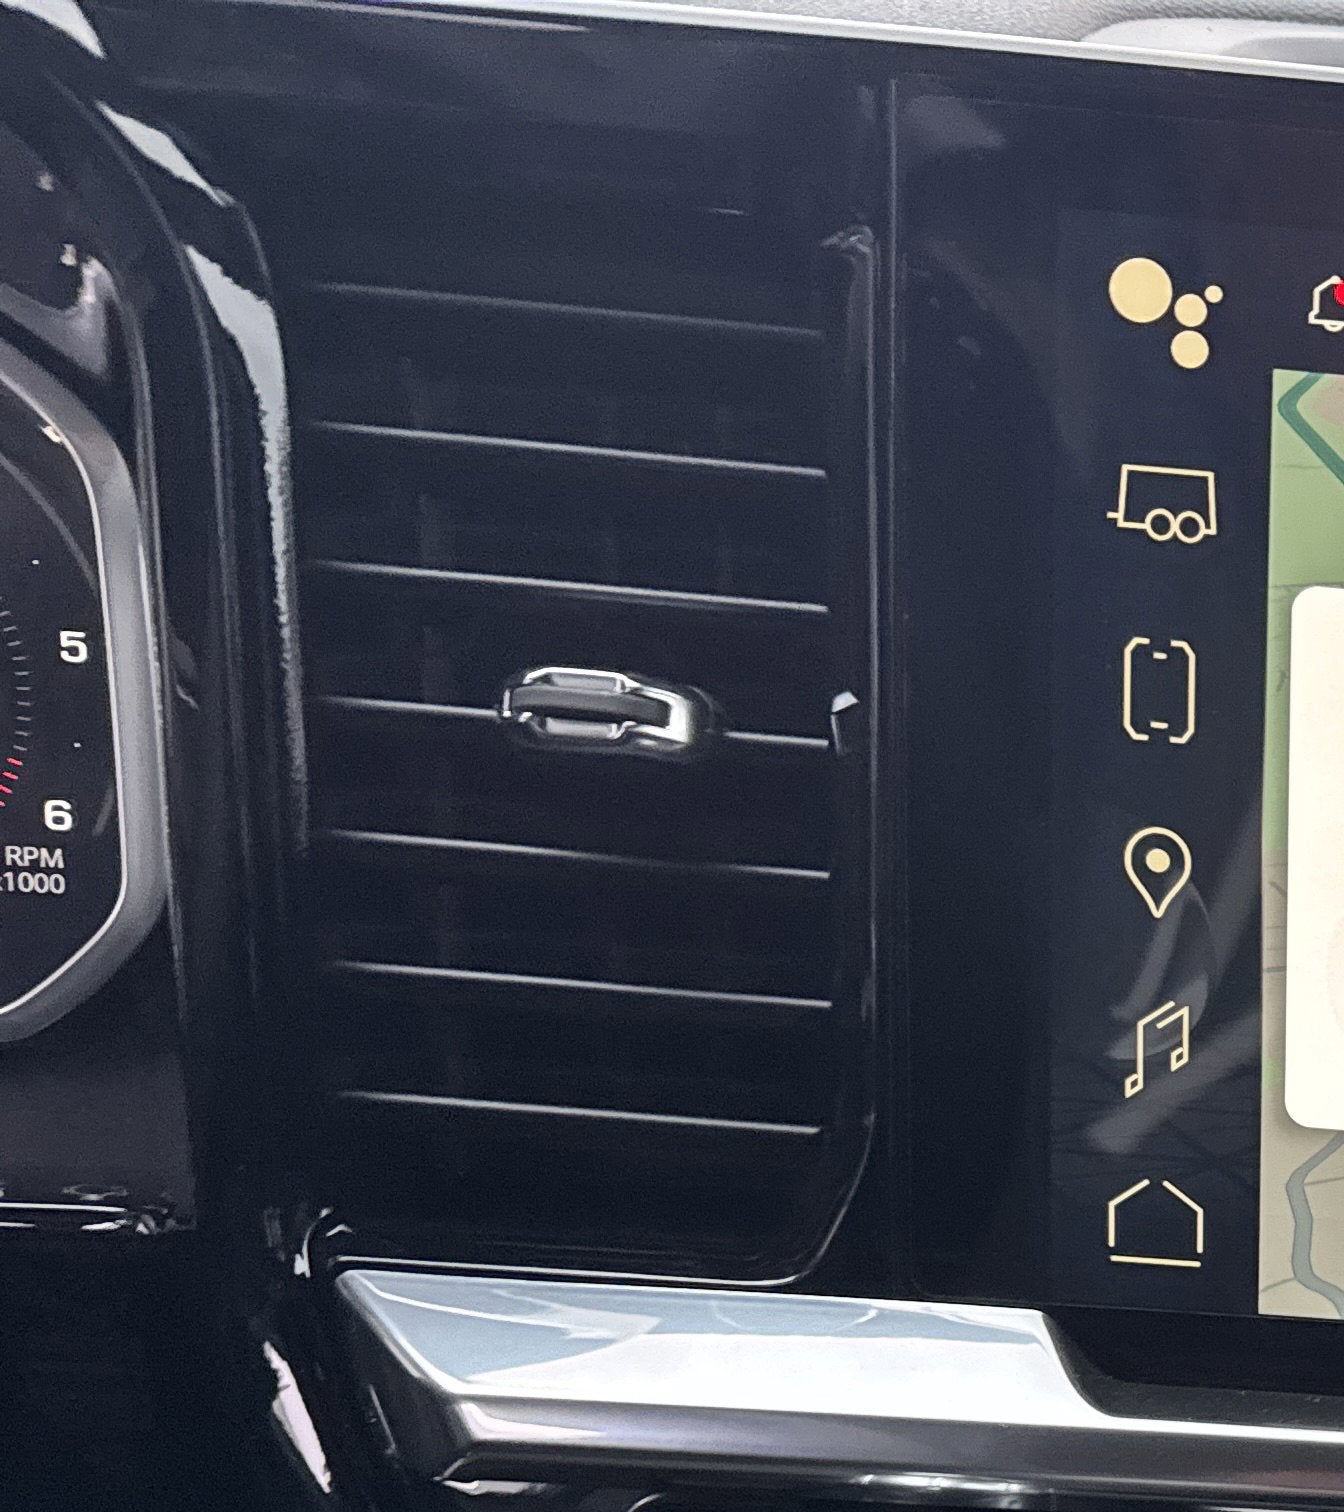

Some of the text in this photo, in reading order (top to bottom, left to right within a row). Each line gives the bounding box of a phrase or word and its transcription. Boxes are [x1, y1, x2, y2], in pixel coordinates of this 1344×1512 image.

[59, 630, 88, 663] 5
[44, 799, 73, 832] 6
[4, 845, 65, 869] RPM
